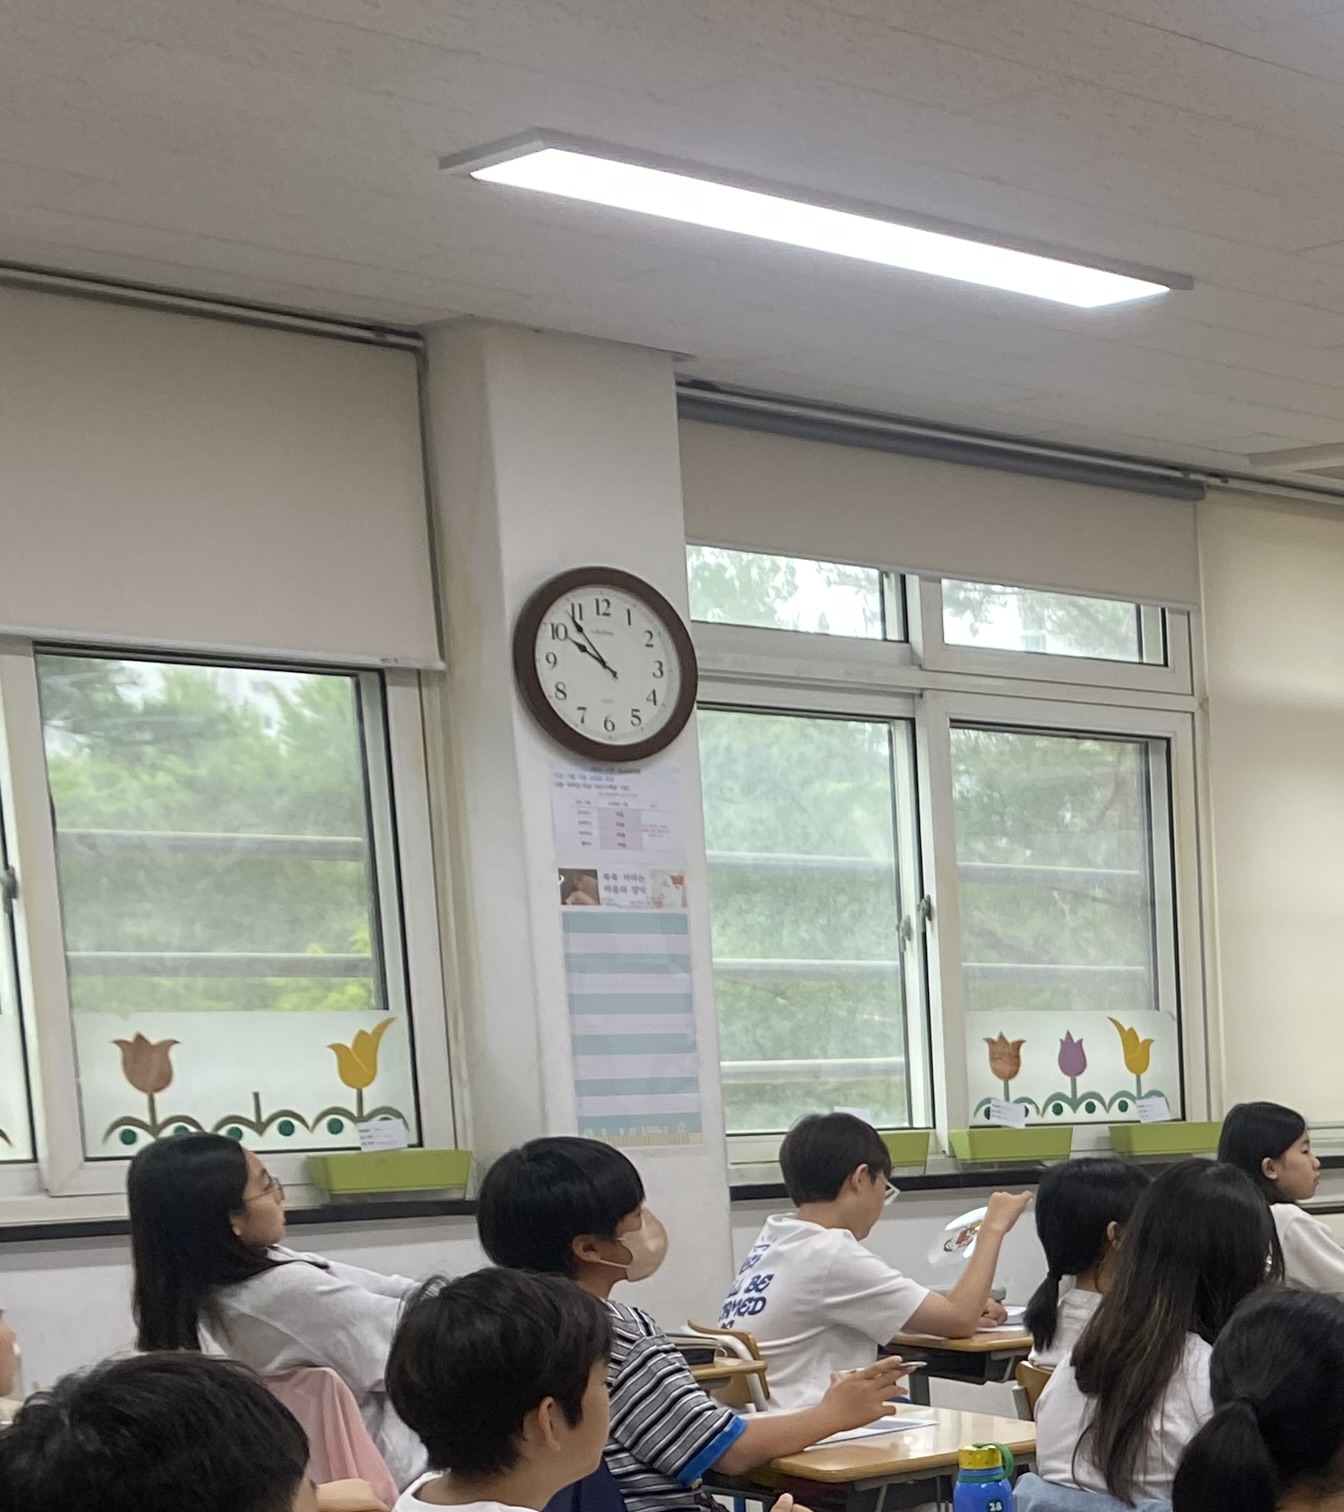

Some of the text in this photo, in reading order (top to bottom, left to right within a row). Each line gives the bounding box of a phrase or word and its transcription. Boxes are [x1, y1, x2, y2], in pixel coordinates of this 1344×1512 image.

[570, 602, 584, 621] 11
[594, 598, 612, 617] 12
[626, 608, 632, 626] 1
[550, 622, 568, 641] 10
[644, 630, 654, 648] 2
[545, 652, 558, 669] 9
[652, 660, 664, 678] 3
[554, 682, 568, 701] 8
[645, 688, 658, 706] 4
[576, 706, 588, 724] 7
[603, 715, 616, 733] 6
[630, 708, 642, 727] 5
[743, 1273, 775, 1294] BE
